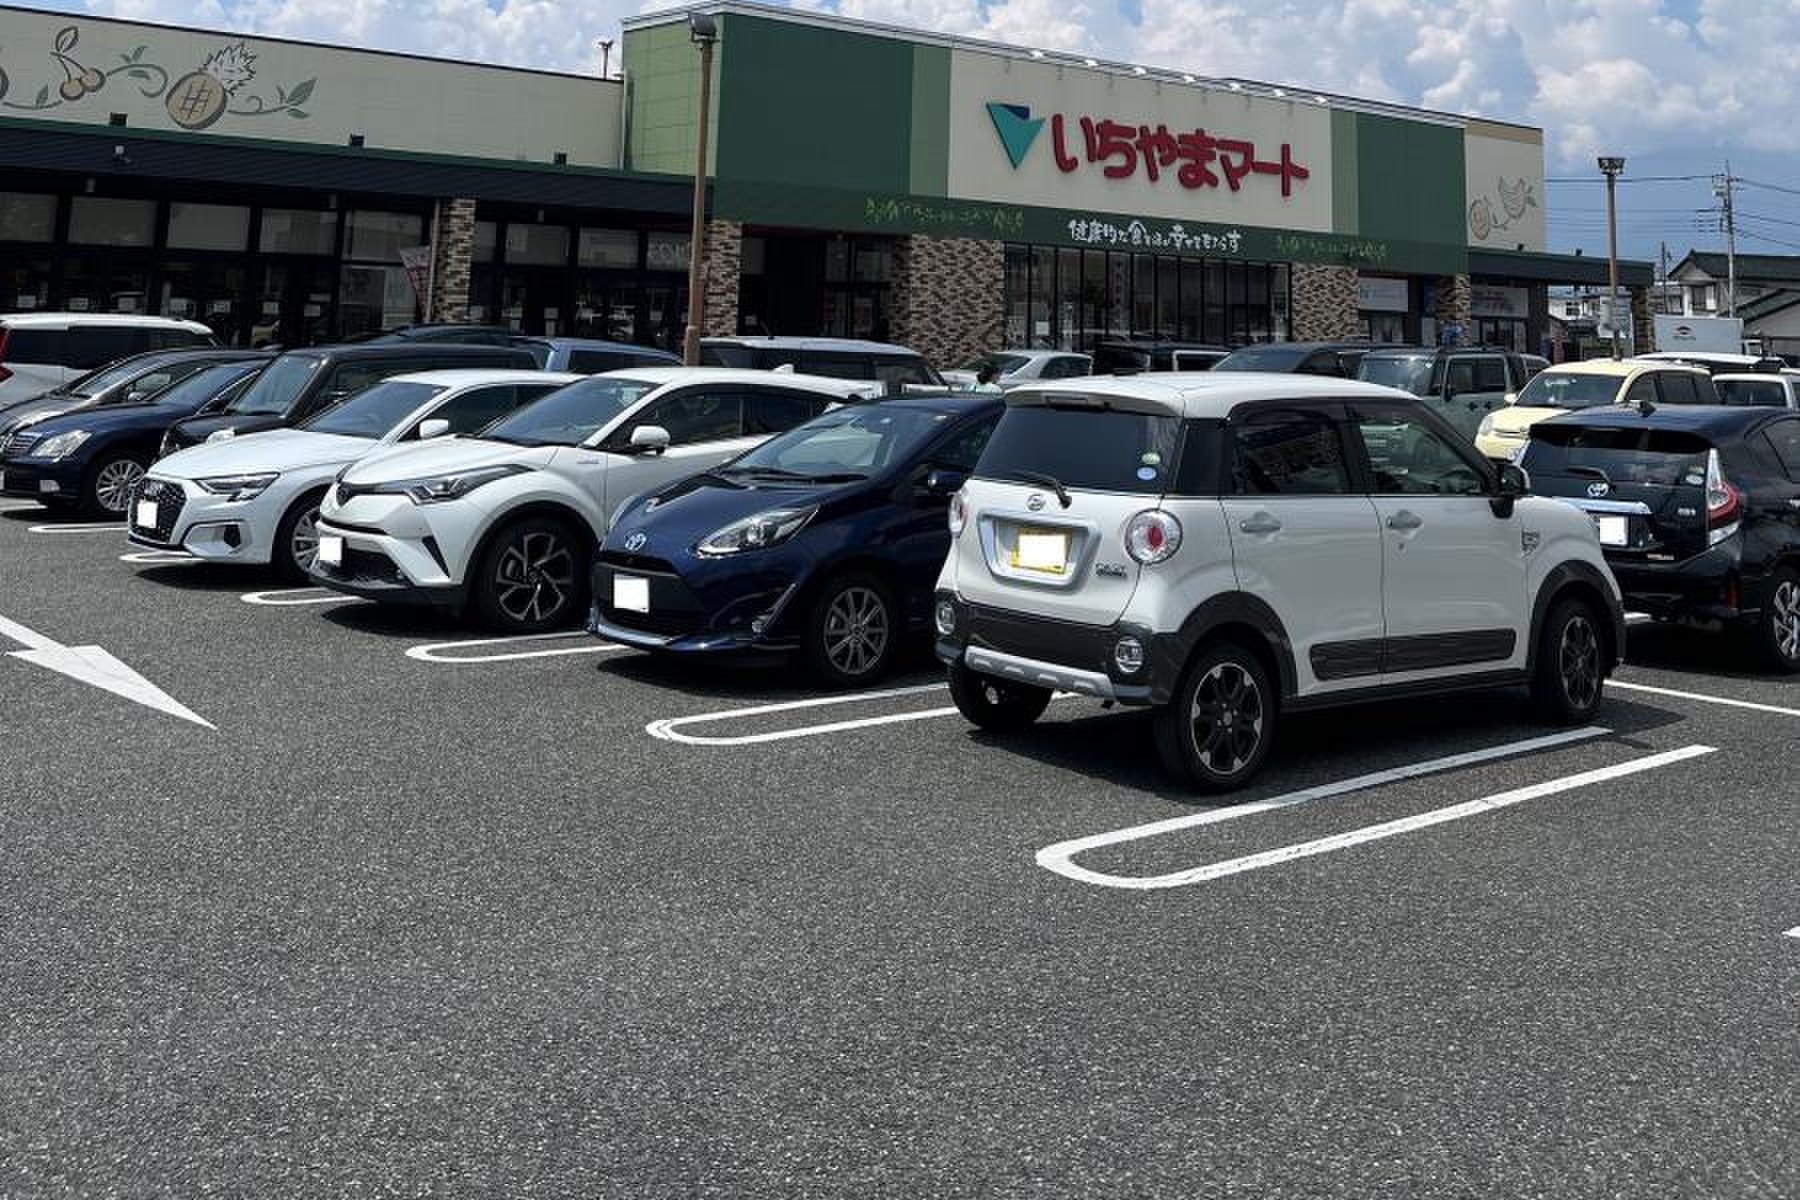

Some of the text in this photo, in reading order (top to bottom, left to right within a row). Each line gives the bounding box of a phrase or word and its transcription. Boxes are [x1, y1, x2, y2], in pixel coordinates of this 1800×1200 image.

[1052, 113, 1310, 197] いちやまマート
